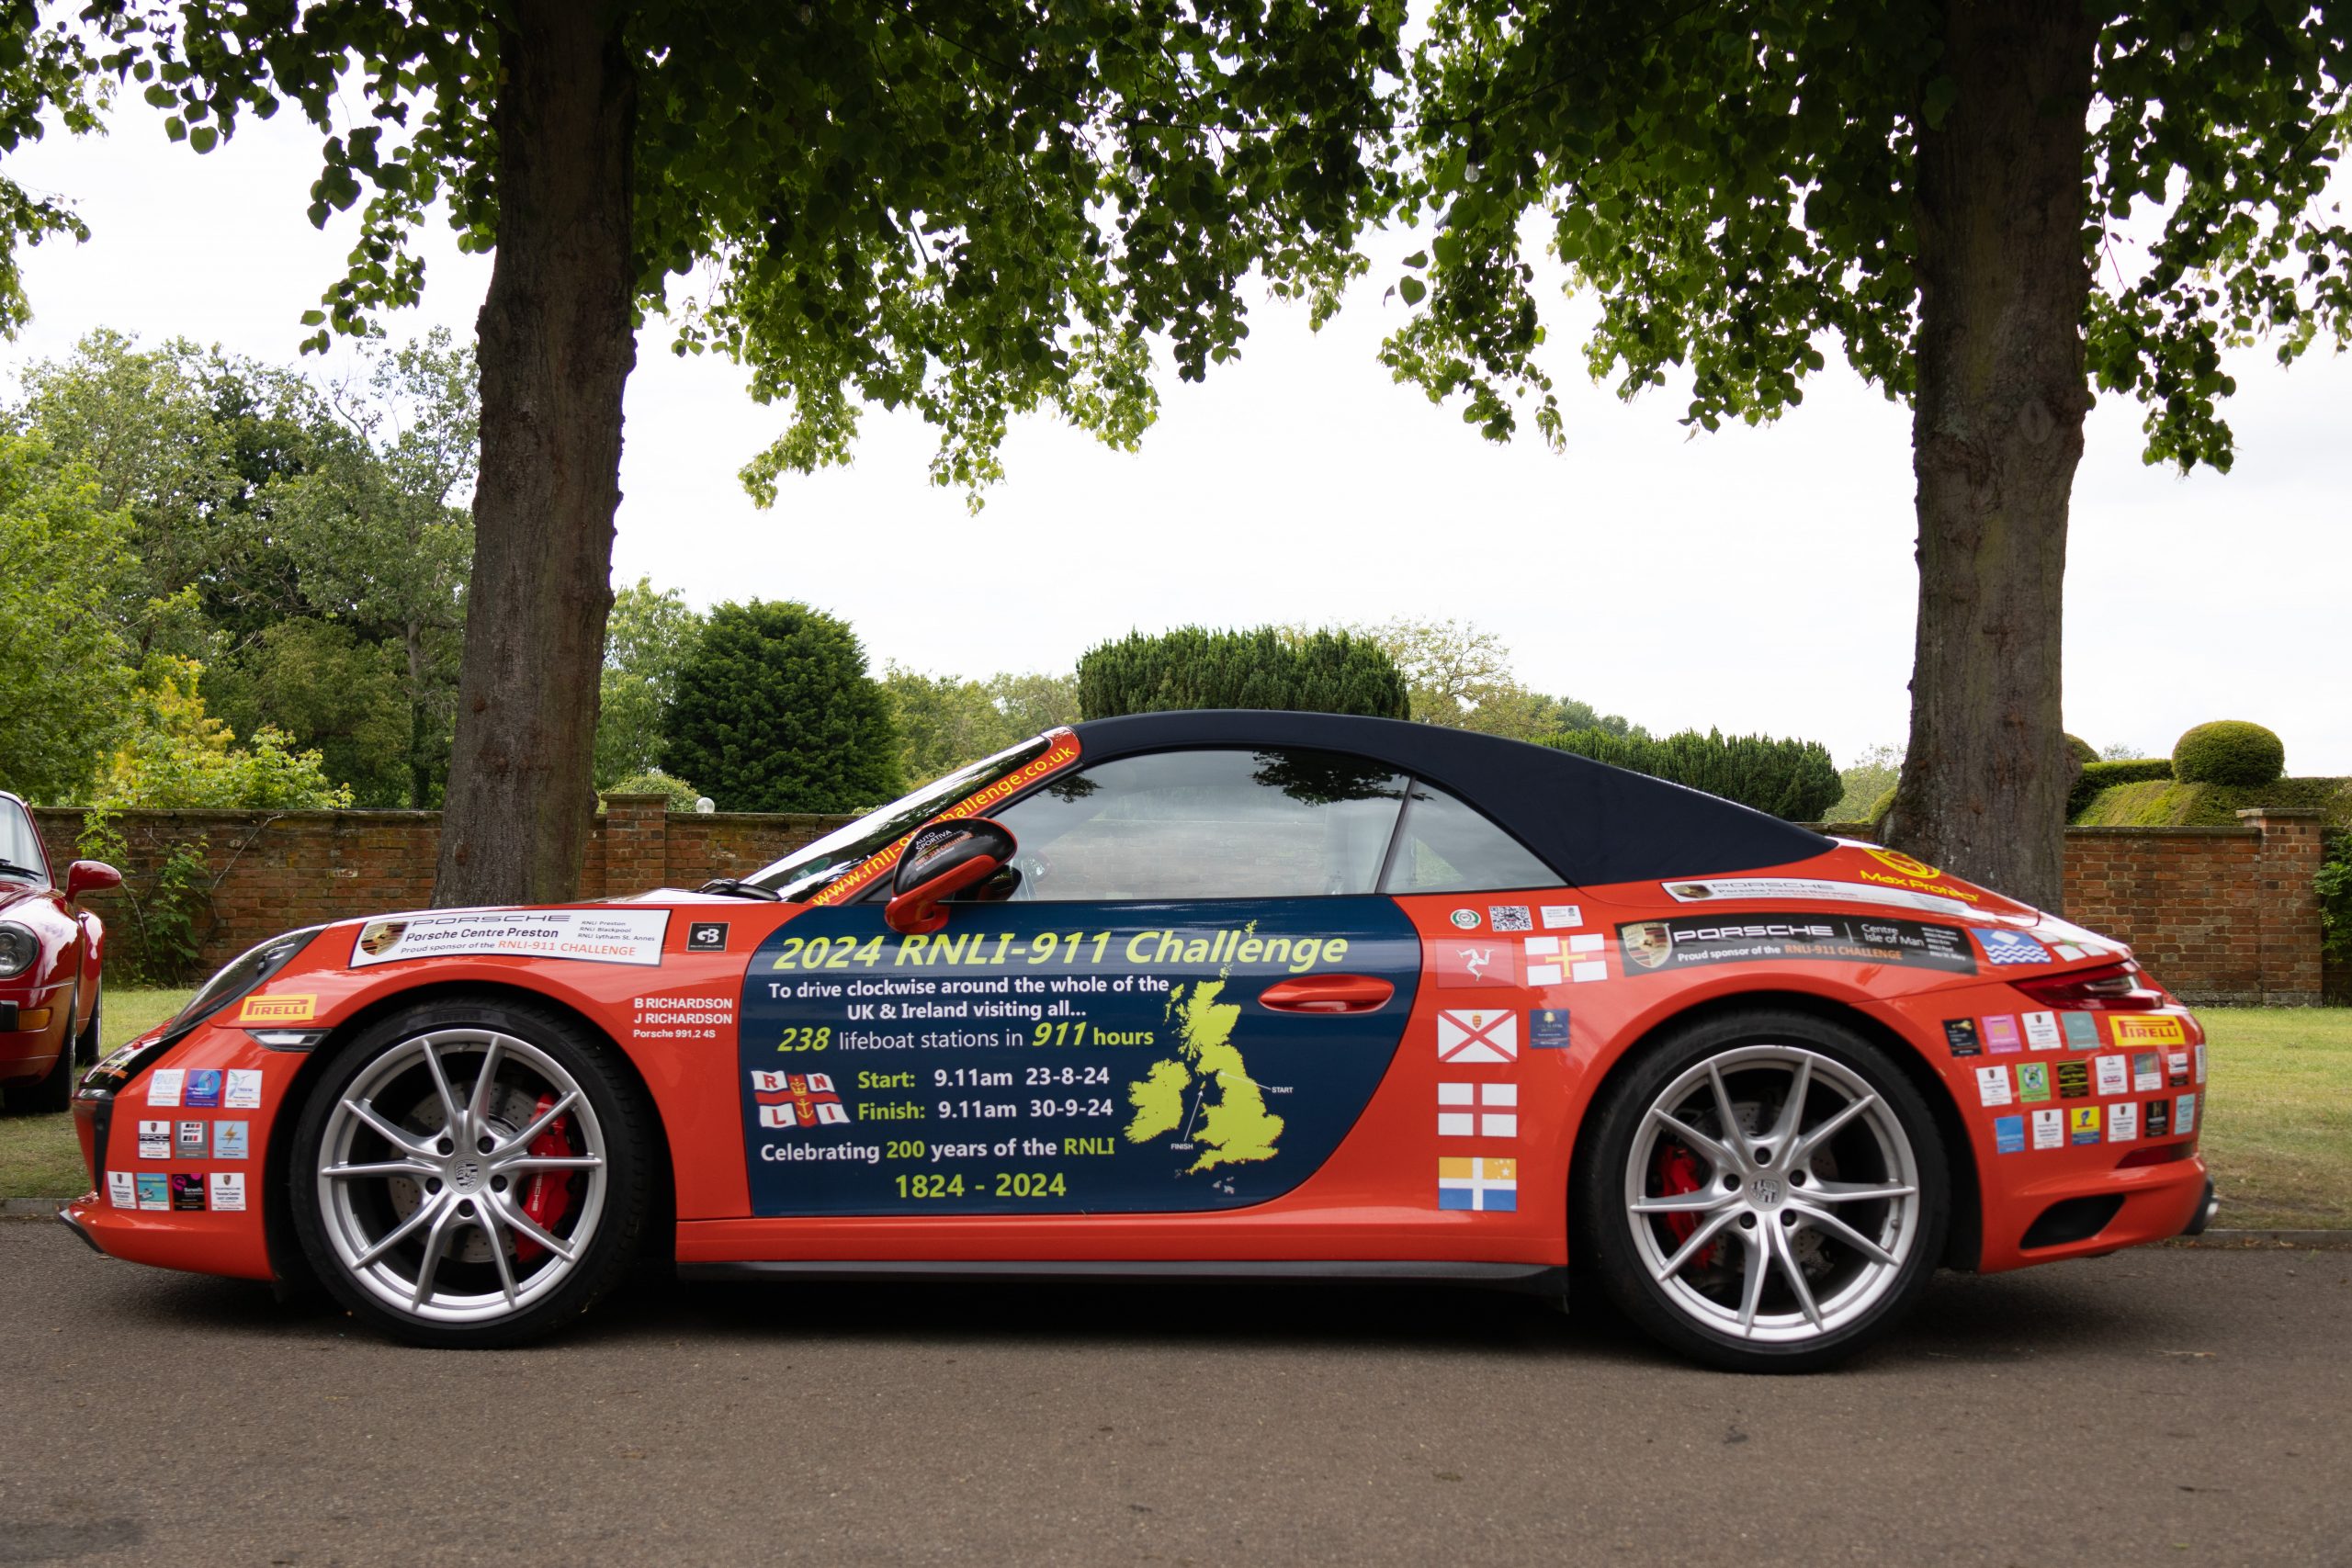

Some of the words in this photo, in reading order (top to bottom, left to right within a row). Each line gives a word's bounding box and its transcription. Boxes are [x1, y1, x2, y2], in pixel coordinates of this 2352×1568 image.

[915, 831, 935, 846] AUTO
[915, 829, 953, 852] SPORTIVA
[1712, 882, 1835, 890] PORSCHE
[1860, 870, 1908, 887] Max
[413, 915, 571, 927] PORSCHE
[1860, 922, 1899, 935] Centre
[405, 930, 458, 942] Porsche
[460, 928, 504, 938] Centre
[506, 927, 559, 938] Preston
[1673, 924, 1835, 942] PORSCHE
[1864, 931, 1883, 942] Isle
[1885, 931, 1898, 943] of
[1899, 935, 1925, 947] Man
[401, 945, 428, 954] Proud
[430, 943, 467, 953] sponsor
[498, 940, 556, 952] RNLI-911
[560, 942, 637, 956] CHALLENGE
[772, 935, 885, 970] 2024
[894, 931, 1112, 966] RNLI-911
[1125, 930, 1349, 973] Challenge
[1678, 949, 1708, 963] Proud
[1710, 946, 1749, 960] sponsor
[1751, 944, 1764, 955] of
[1764, 944, 1781, 954] the
[1784, 944, 1836, 955] RNLI-911
[1838, 945, 1903, 961] CHALLENGE
[768, 982, 791, 998] To
[797, 982, 842, 998] drive
[847, 979, 936, 996] clockwise
[941, 976, 1009, 994] around
[1013, 977, 1046, 993] the
[1050, 976, 1107, 992] whole
[1113, 976, 1134, 992] of
[1137, 976, 1170, 992] the
[245, 998, 310, 1016] PIRELLI
[634, 998, 643, 1009] B
[646, 998, 733, 1009] RICHARDSON
[847, 1003, 875, 1021] UK
[878, 1003, 897, 1020] &
[901, 1001, 967, 1019] Ireland
[973, 1001, 1042, 1021] visiting
[1047, 999, 1087, 1017] all...
[634, 1013, 642, 1024] J
[645, 1013, 732, 1024] RICHARDSON
[633, 1029, 674, 1038] Porsche
[675, 1030, 701, 1038] 991.2
[703, 1030, 717, 1038] 4S
[776, 1026, 831, 1053] 238
[839, 1030, 914, 1050] lifeboat
[921, 1029, 999, 1048] stations
[1005, 1028, 1023, 1047] in
[1032, 1021, 1087, 1047] 911
[1093, 1027, 1155, 1046] hours
[2117, 1020, 2179, 1038] PIRELLI
[763, 1074, 779, 1089] R
[812, 1075, 828, 1089] N
[857, 1070, 916, 1089] Start:
[933, 1068, 1013, 1087] 9.11am
[1025, 1066, 1111, 1086] 23-8-24
[772, 1109, 786, 1125] L
[826, 1105, 837, 1120] I
[857, 1101, 926, 1121] Finish:
[938, 1100, 1017, 1119] 9.11am
[1030, 1099, 1114, 1118] 30-9-24
[761, 1141, 880, 1165] Celebrating
[886, 1140, 925, 1159] 200
[930, 1141, 988, 1162] years
[993, 1137, 1017, 1156] of
[1023, 1137, 1057, 1156] the
[1064, 1137, 1115, 1156] RNLI
[895, 1174, 965, 1199] 1824
[995, 1172, 1067, 1197] 2024
